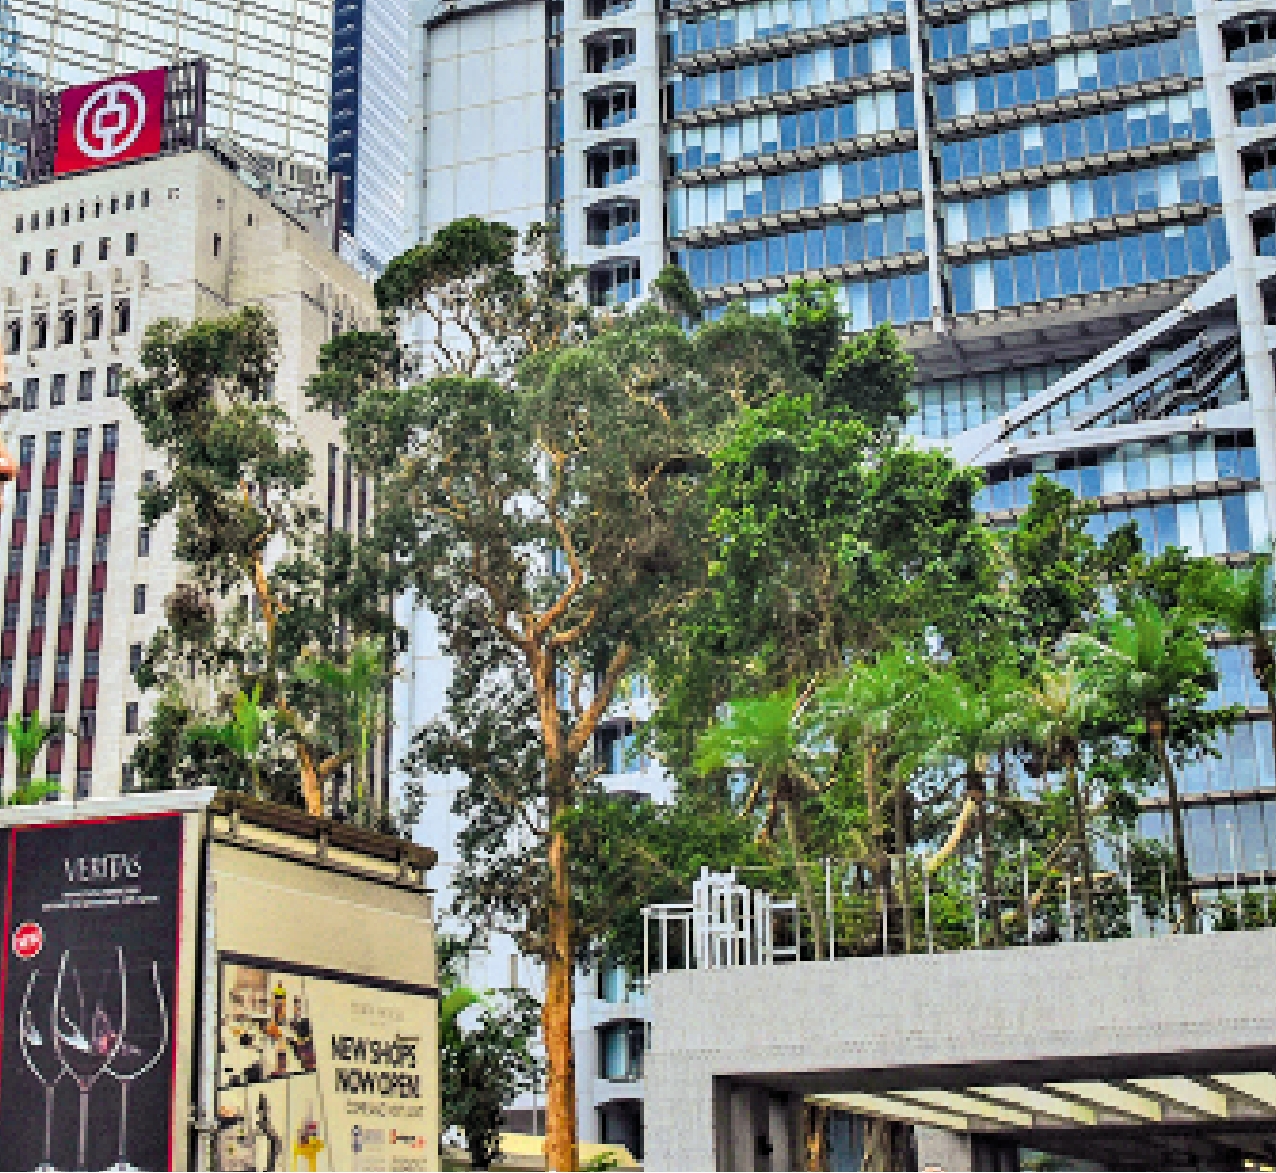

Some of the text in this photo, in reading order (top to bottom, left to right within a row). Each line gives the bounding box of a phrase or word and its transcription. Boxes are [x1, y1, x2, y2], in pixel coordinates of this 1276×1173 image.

[64, 853, 142, 882] VERITAS
[331, 1034, 417, 1069] NEW SHOPS
[334, 1068, 374, 1095] NOW
